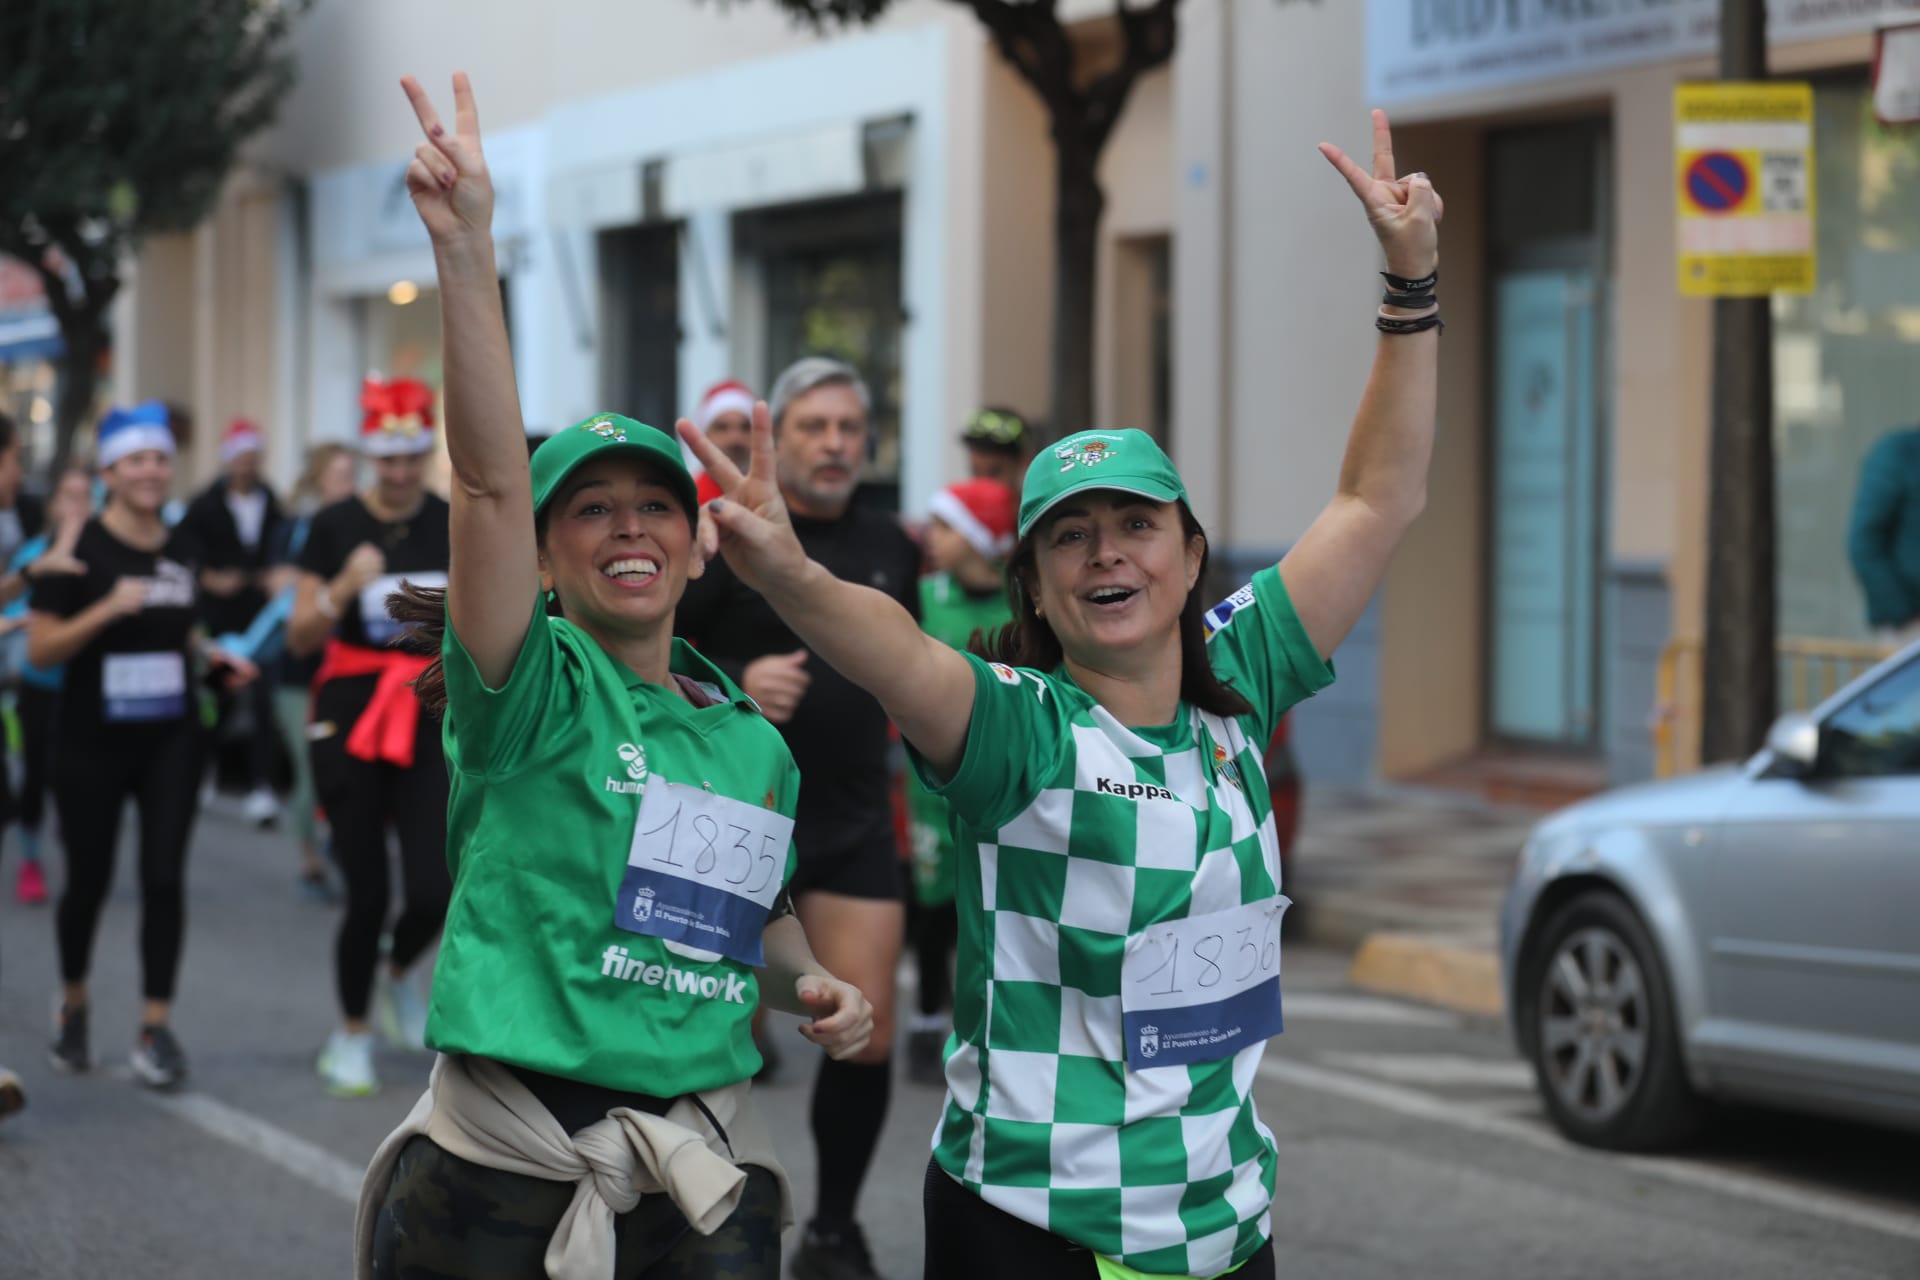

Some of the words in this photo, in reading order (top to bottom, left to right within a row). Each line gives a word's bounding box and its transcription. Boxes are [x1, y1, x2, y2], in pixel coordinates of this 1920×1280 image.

[605, 775, 644, 795] humm
[1096, 776, 1173, 800] Kappa
[642, 801, 777, 893] 1835
[663, 912, 689, 925] Puerto
[1136, 908, 1278, 996] 1836
[601, 944, 748, 1005] finetwork
[1162, 1041, 1171, 1049] El
[1171, 1039, 1198, 1048] Puerto
[1198, 1036, 1209, 1045] de
